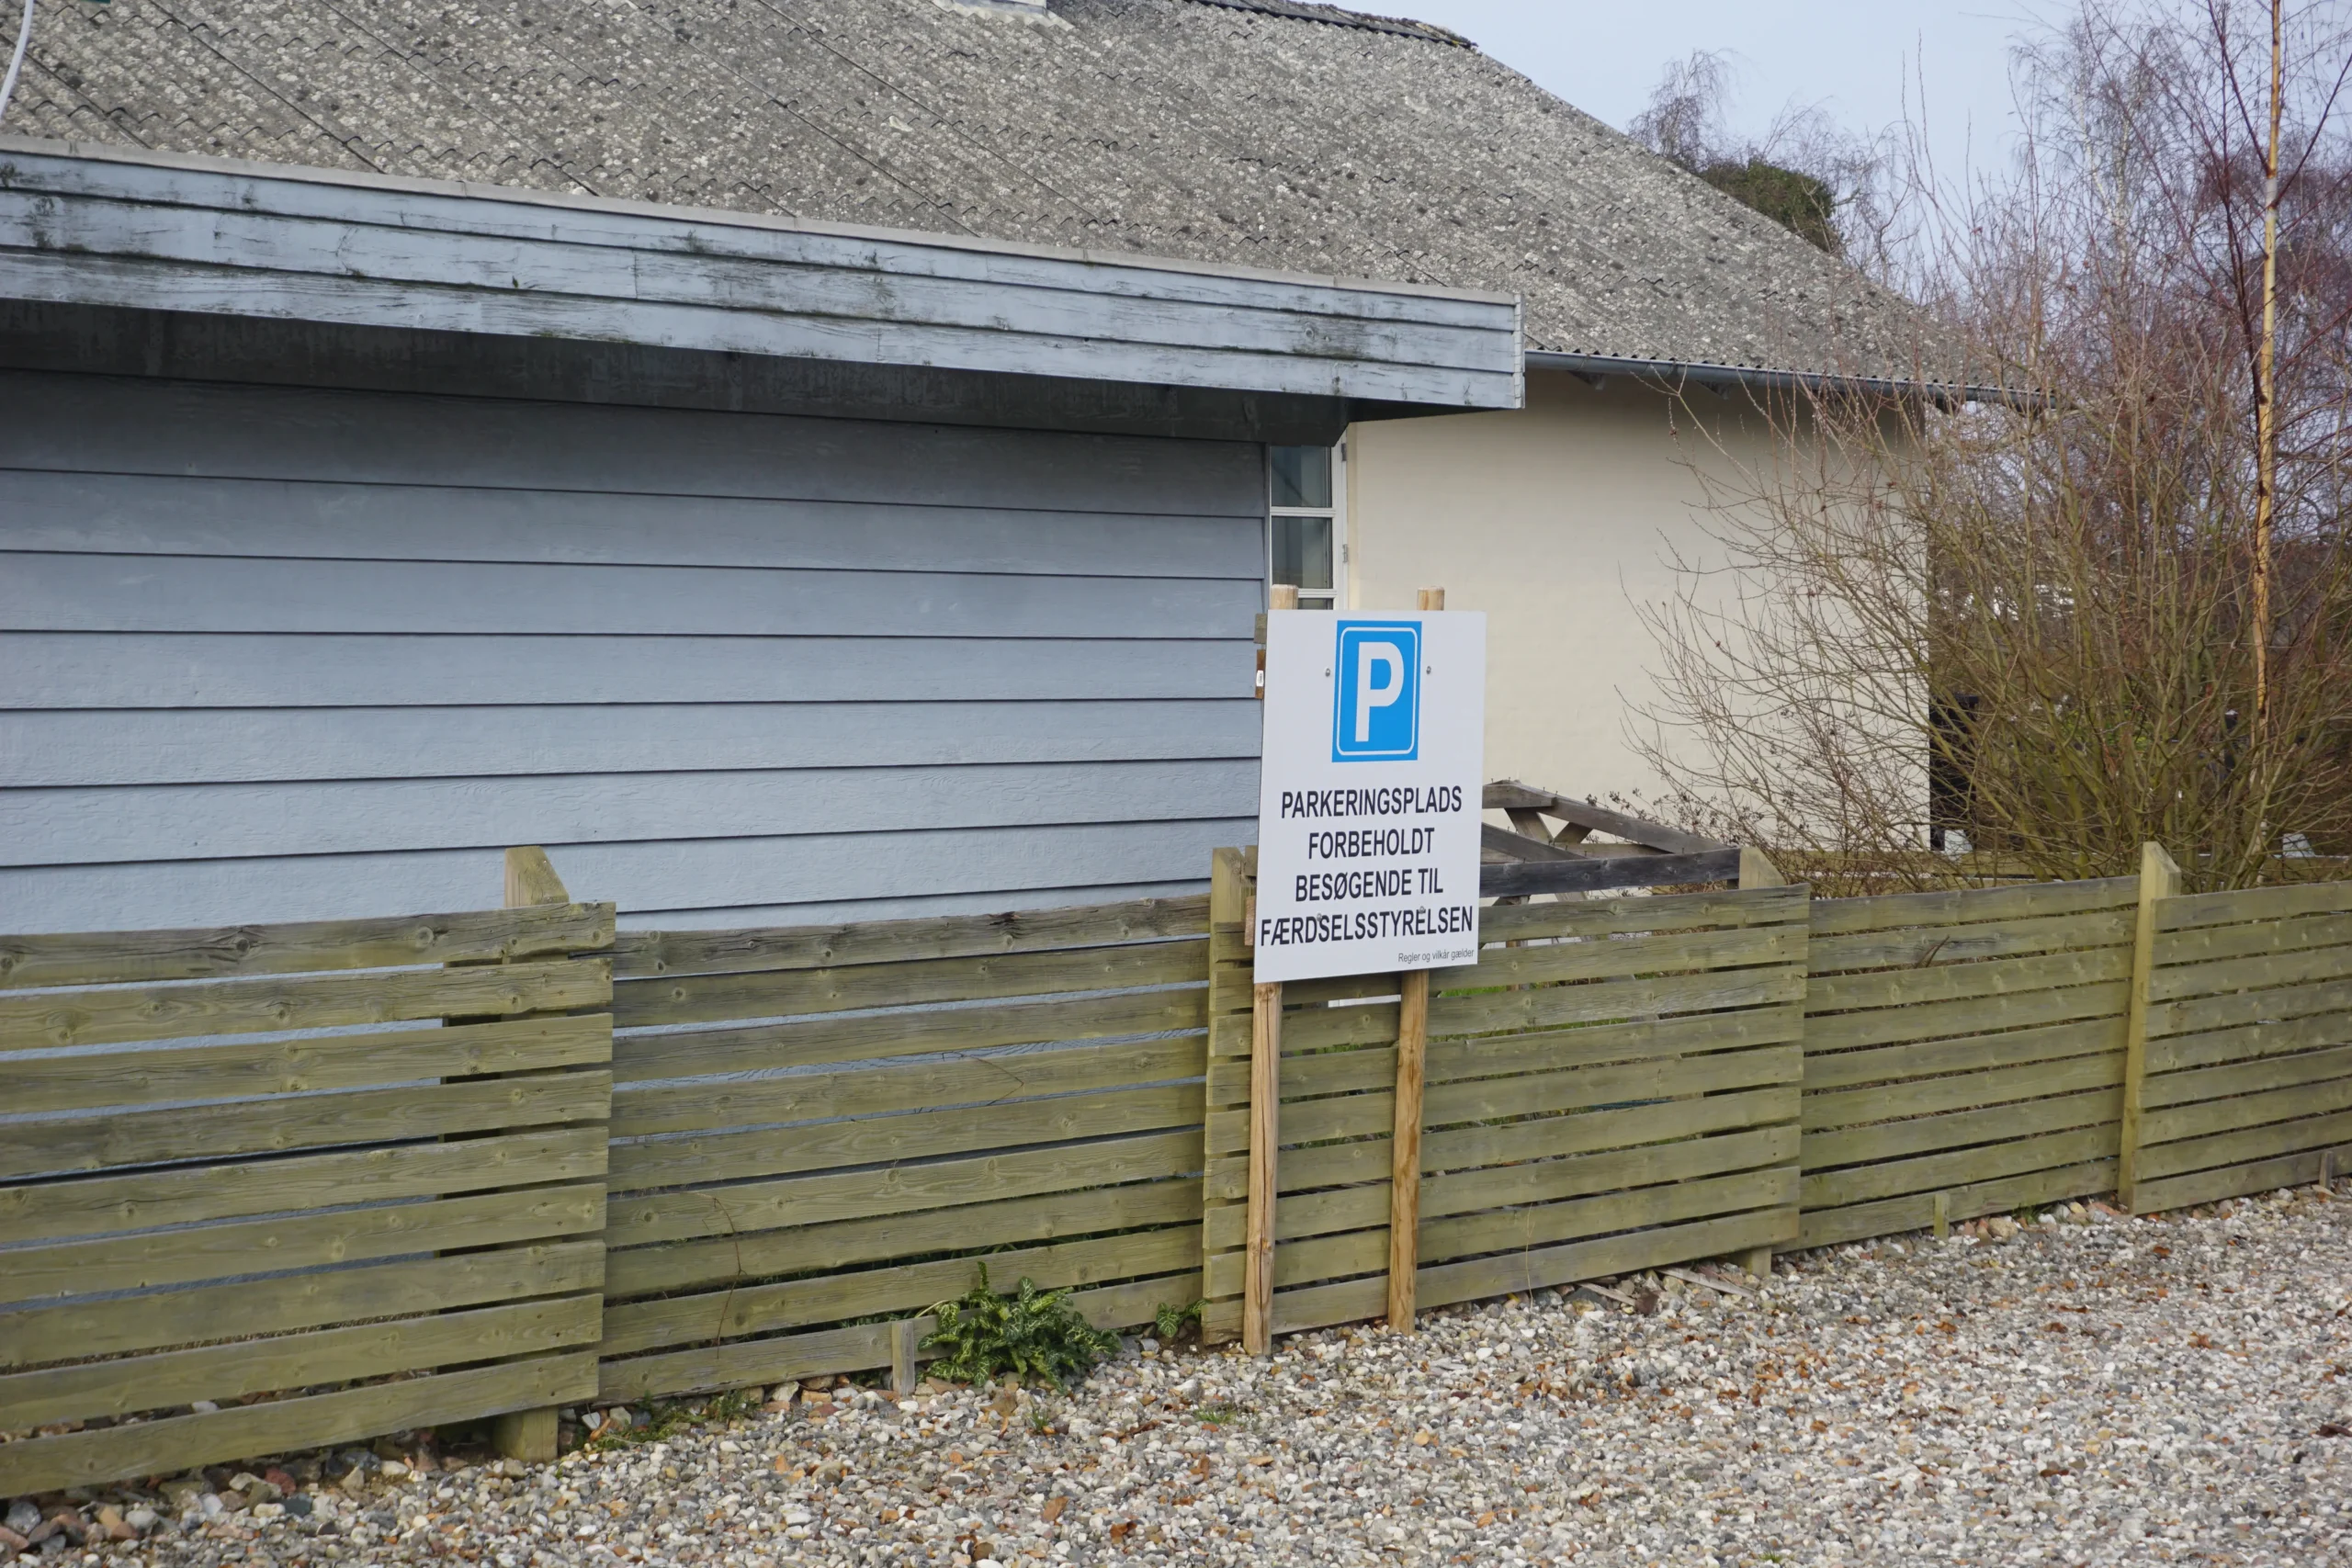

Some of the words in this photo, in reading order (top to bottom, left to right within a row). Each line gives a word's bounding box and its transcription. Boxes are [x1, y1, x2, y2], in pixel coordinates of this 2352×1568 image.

[1355, 641, 1404, 742] P
[1281, 785, 1463, 819] PARKERINGSPLADS
[1308, 827, 1435, 860] FORBEHOLDT
[1295, 868, 1412, 902] BESØGENDE
[1418, 867, 1444, 895] TIL
[1261, 905, 1473, 947] FÆRDSELSSTYRELSEN
[1398, 953, 1420, 964] Regler
[1422, 953, 1430, 963] og
[1432, 950, 1449, 960] vilkår
[1451, 948, 1475, 961] gælder
